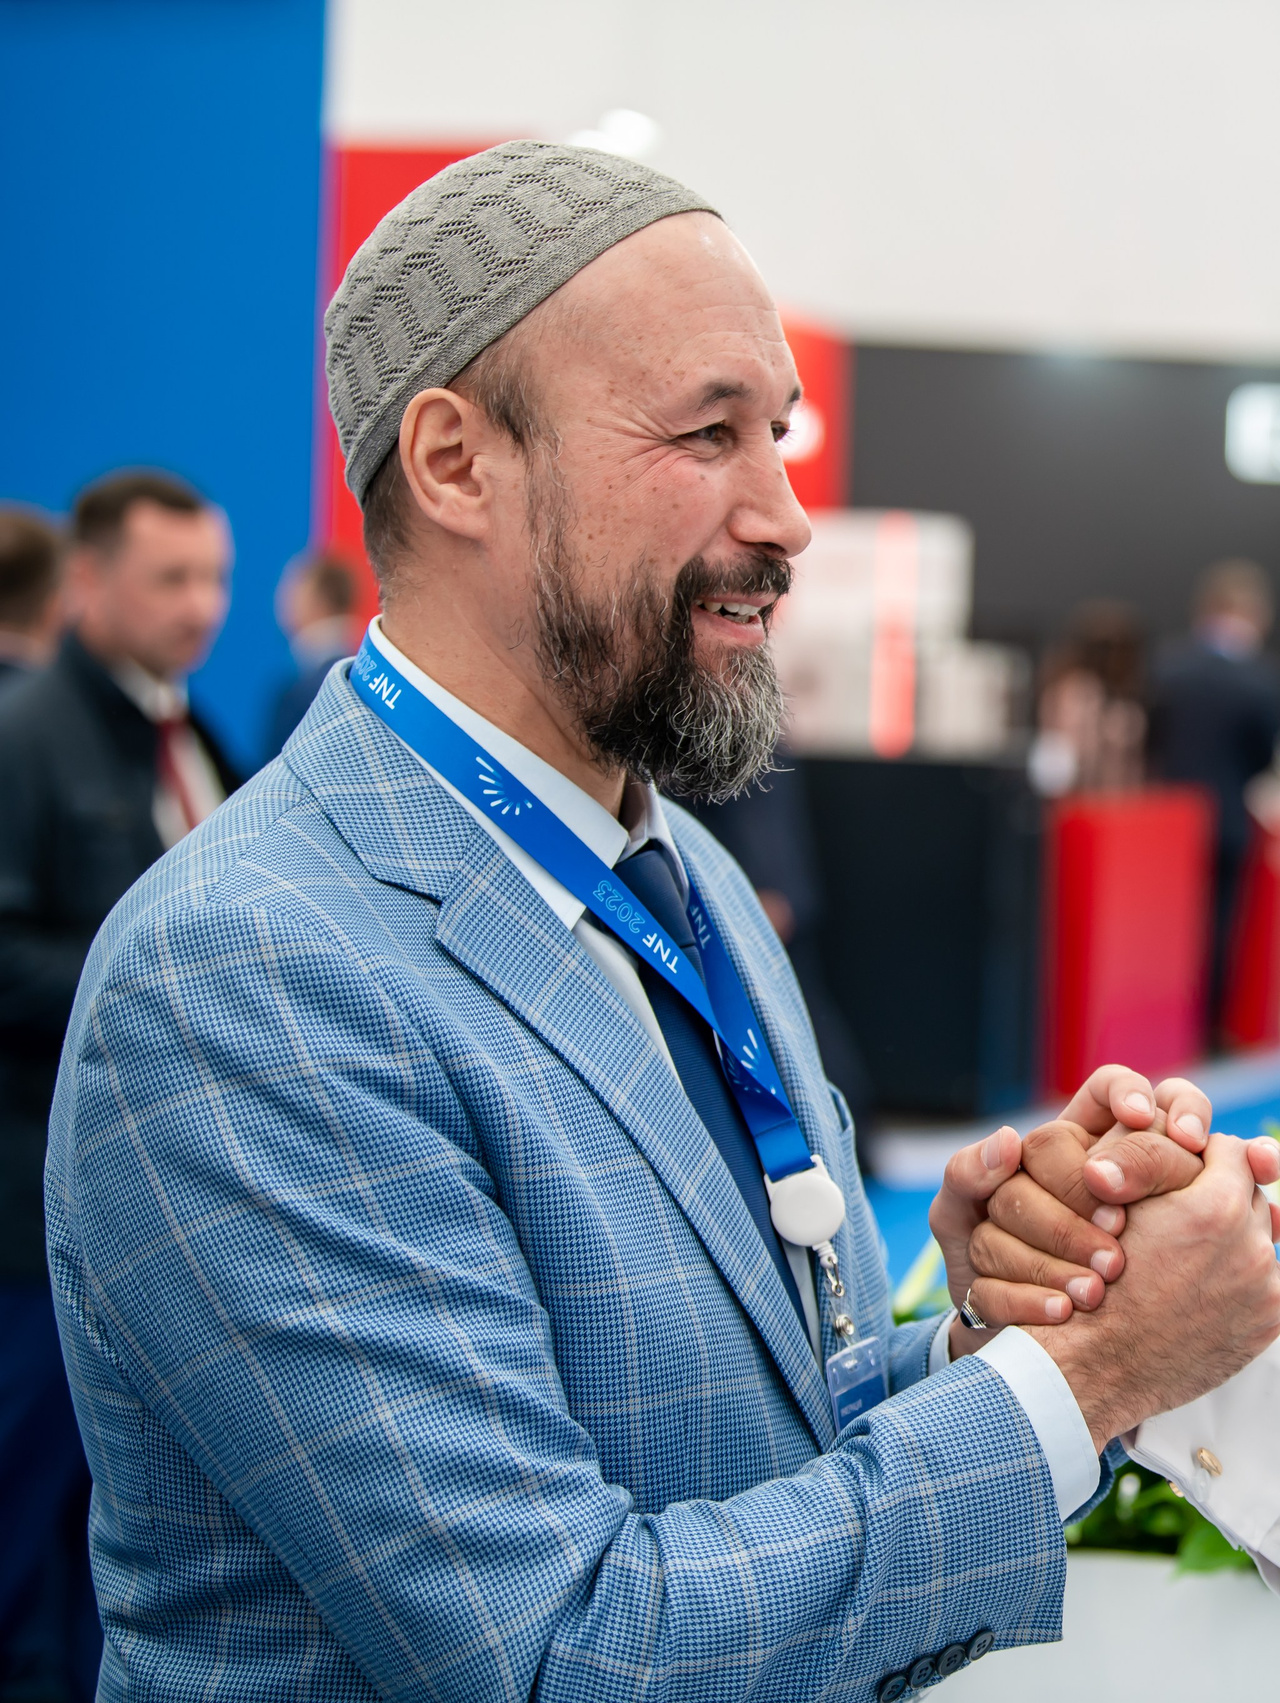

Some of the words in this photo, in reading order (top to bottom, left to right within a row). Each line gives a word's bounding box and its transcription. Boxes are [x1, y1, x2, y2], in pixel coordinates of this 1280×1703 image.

[354, 646, 377, 681] 202
[368, 672, 402, 710] TNF
[592, 880, 646, 934] 2023
[642, 933, 679, 974] TNF
